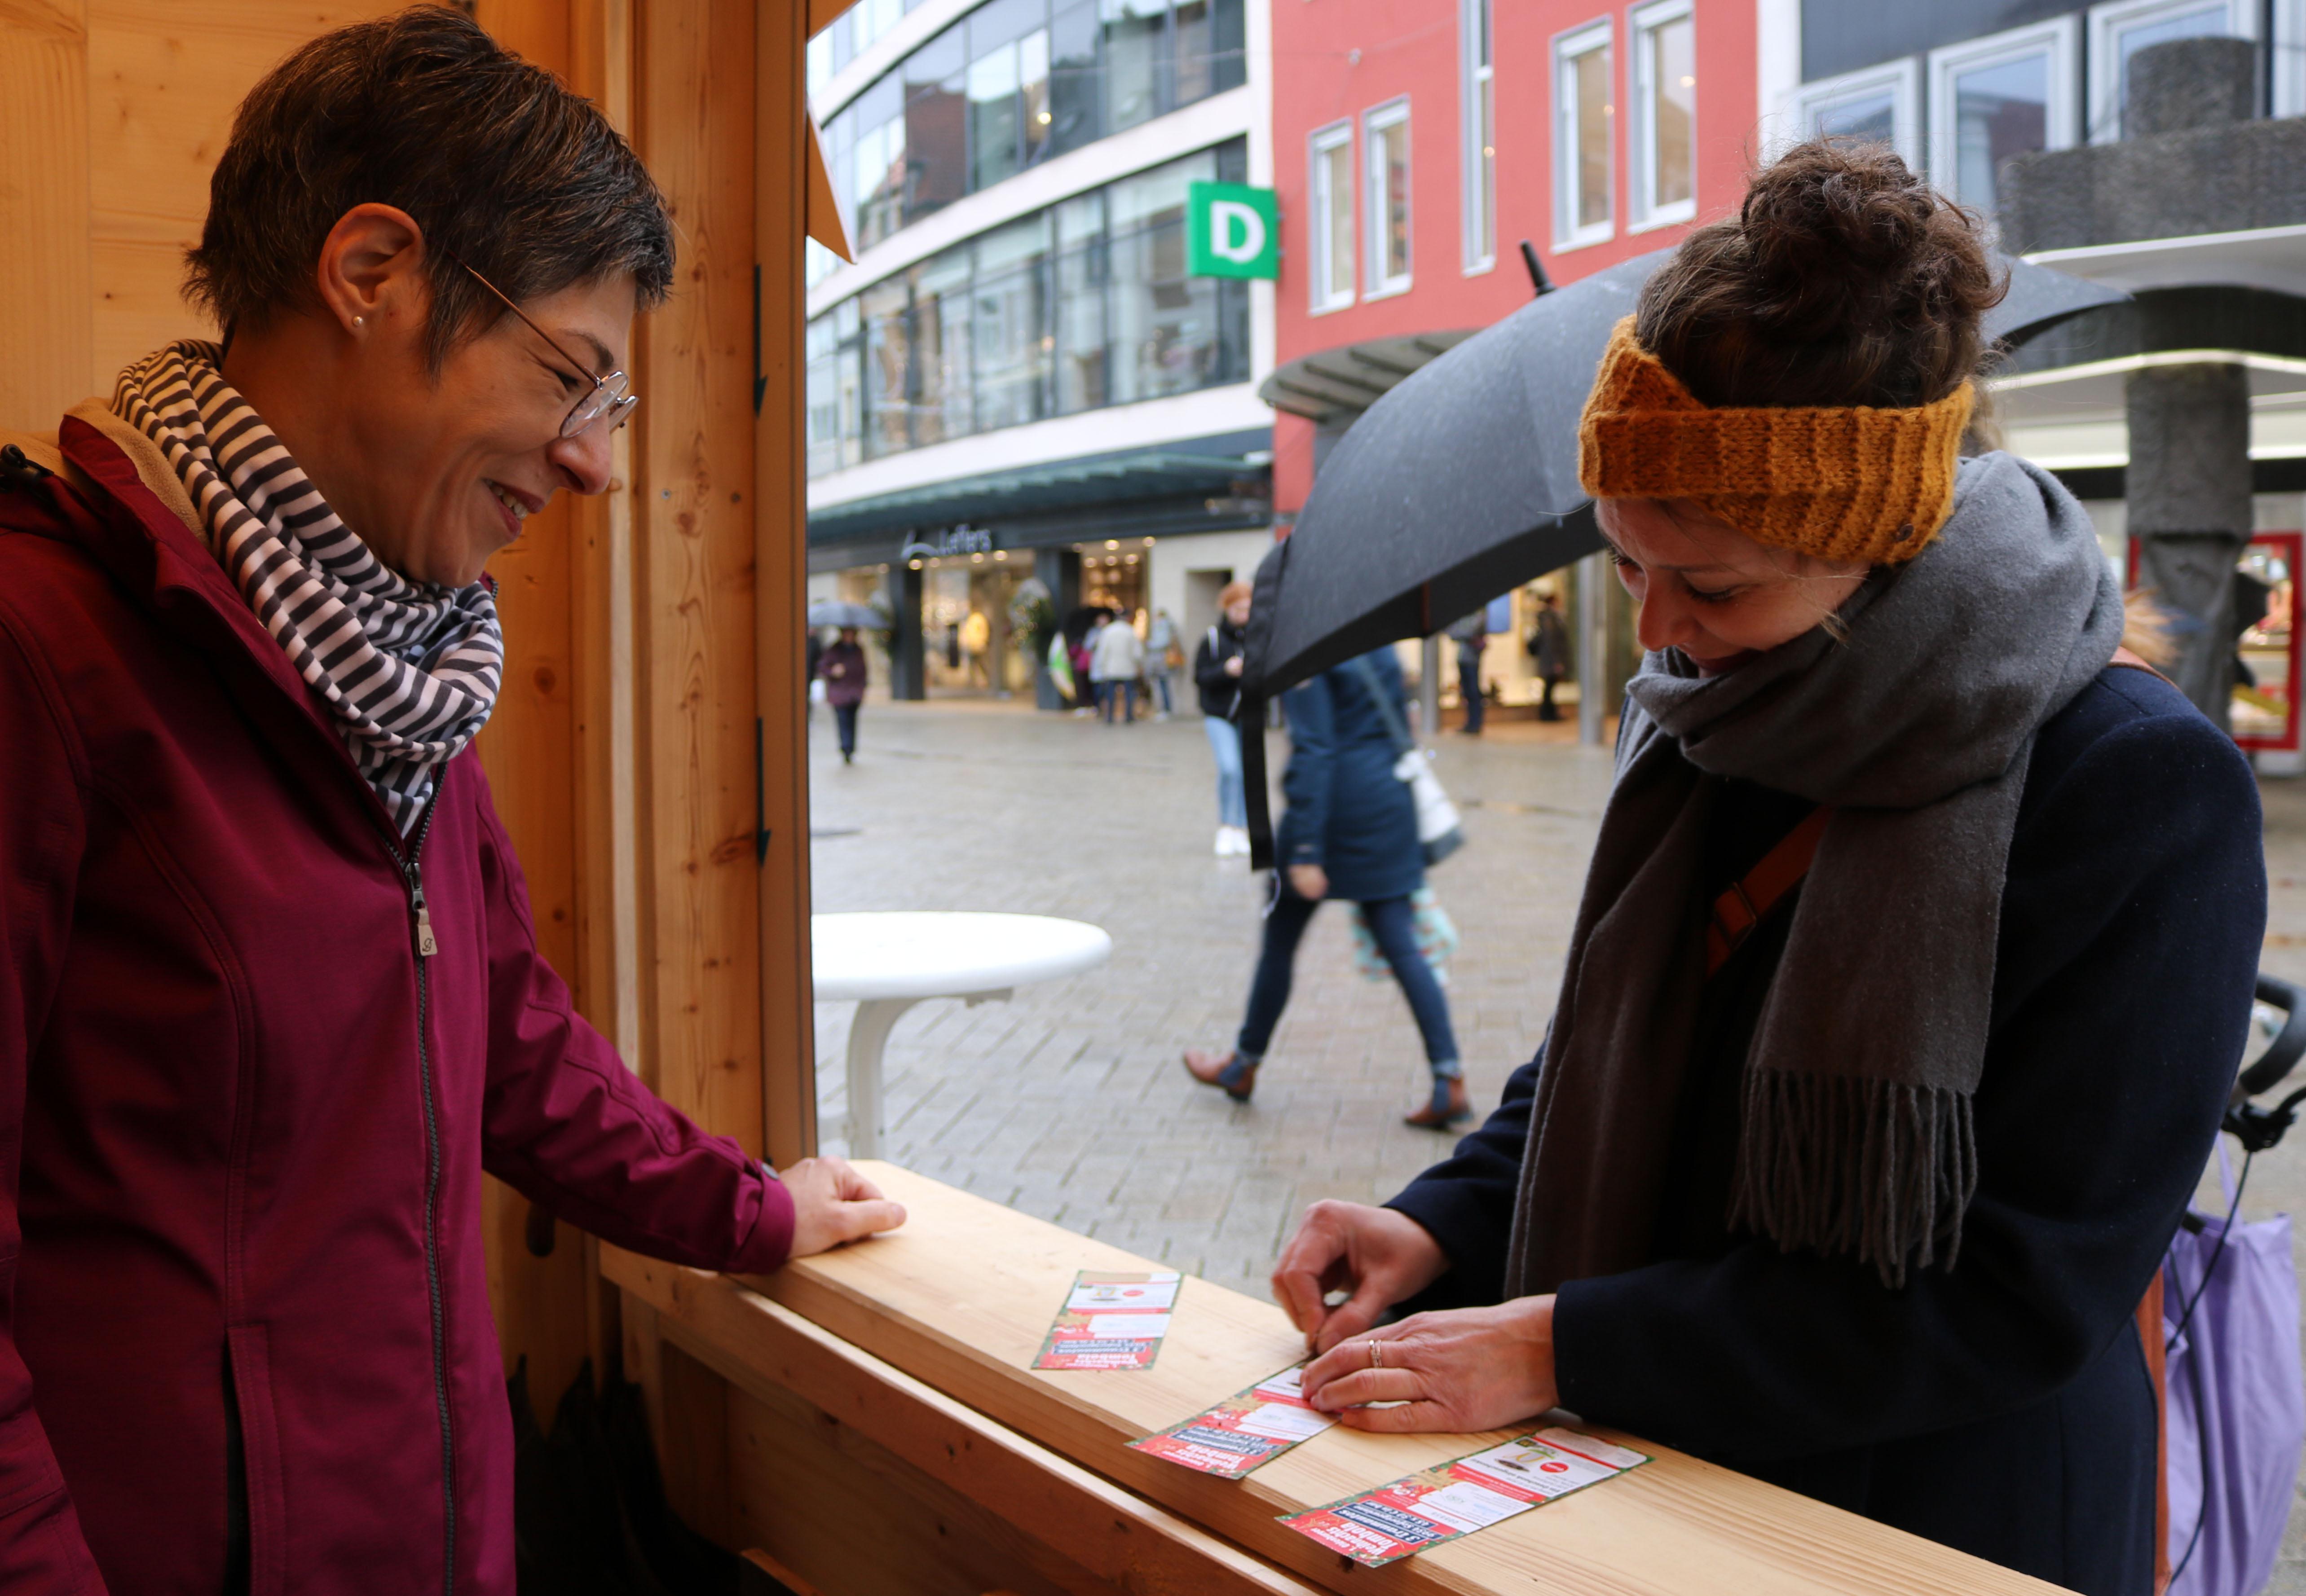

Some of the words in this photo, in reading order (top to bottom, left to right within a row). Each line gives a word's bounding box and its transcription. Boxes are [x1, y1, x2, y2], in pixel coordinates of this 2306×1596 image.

[1210, 200, 1266, 264] D
[1326, 1526, 1386, 1556] Weihnachts
[1340, 1522, 1398, 1549] Tombola
